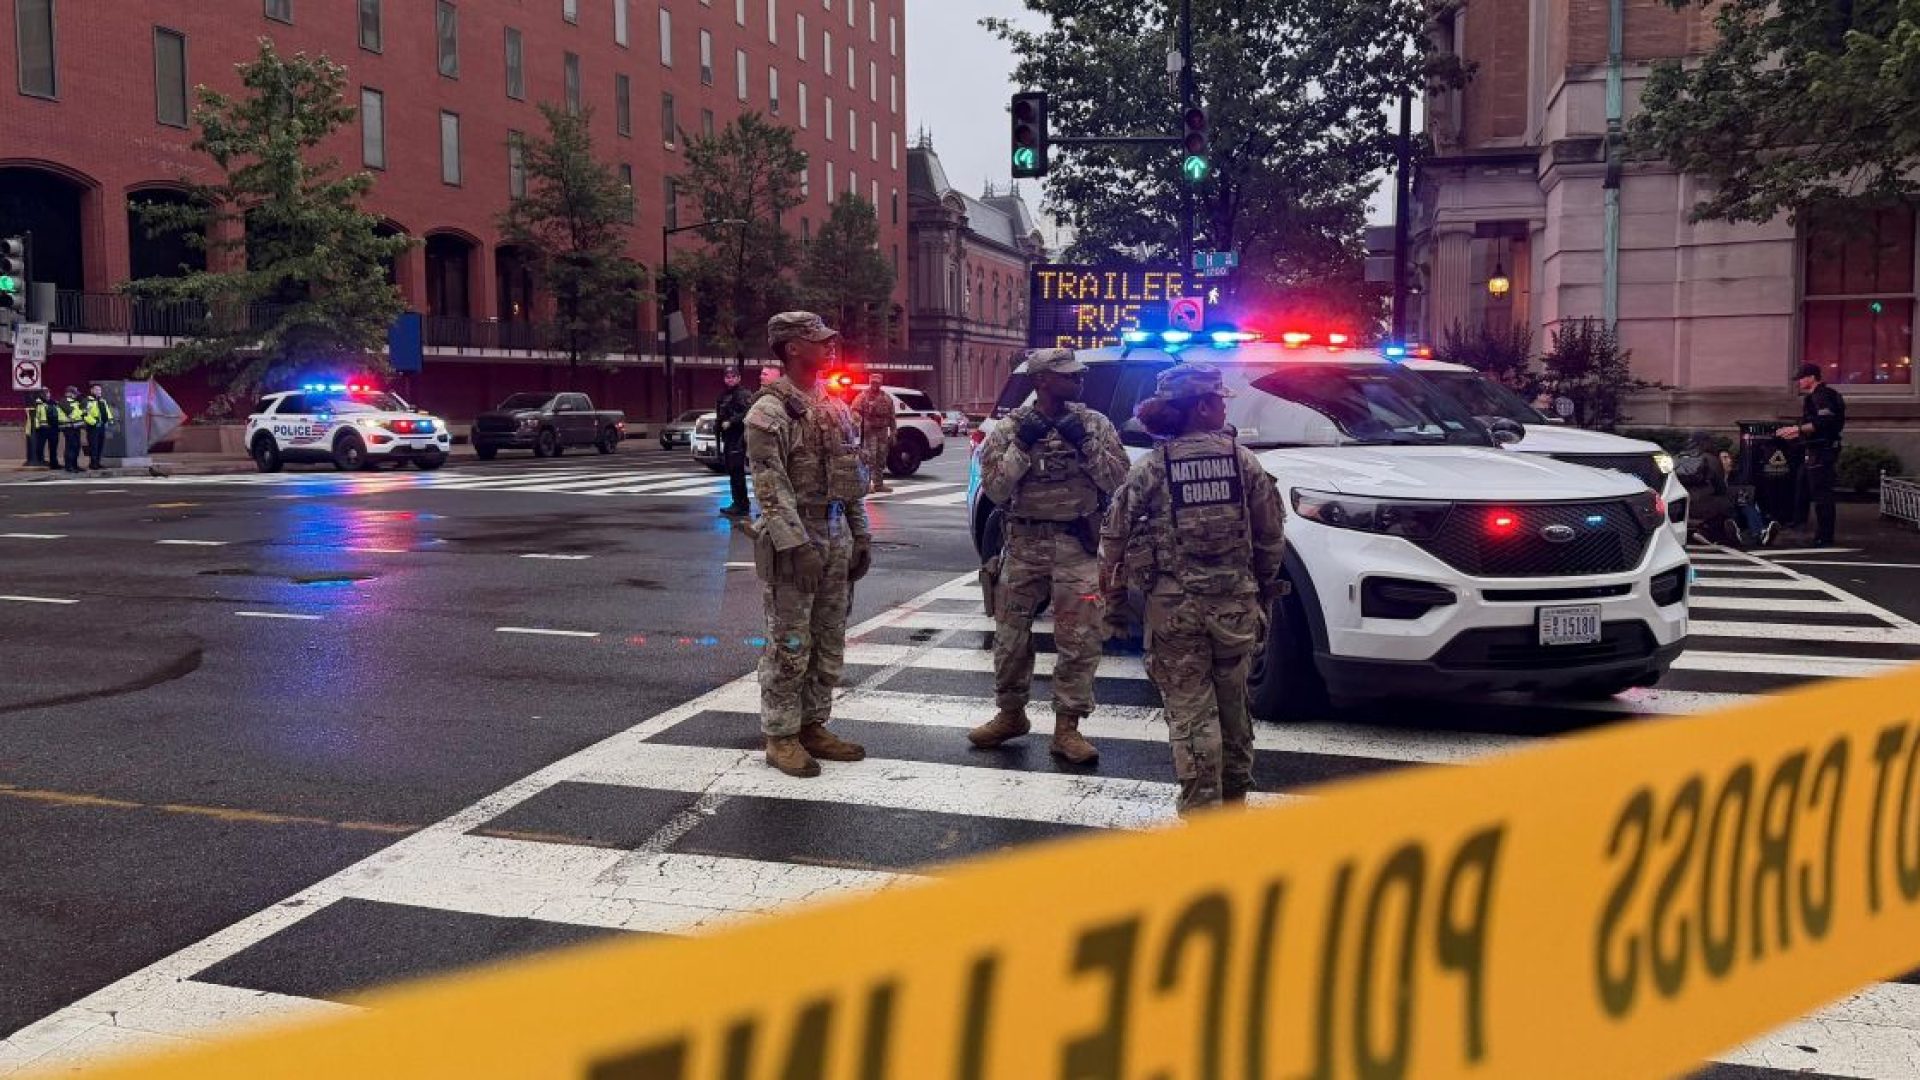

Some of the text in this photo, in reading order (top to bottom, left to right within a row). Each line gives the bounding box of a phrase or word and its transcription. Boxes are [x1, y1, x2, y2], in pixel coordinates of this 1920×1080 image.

[1078, 304, 1141, 333] RVS
[274, 425, 311, 437] POLICE
[1171, 457, 1237, 483] NATIONAL
[1182, 481, 1231, 504] GUARD
